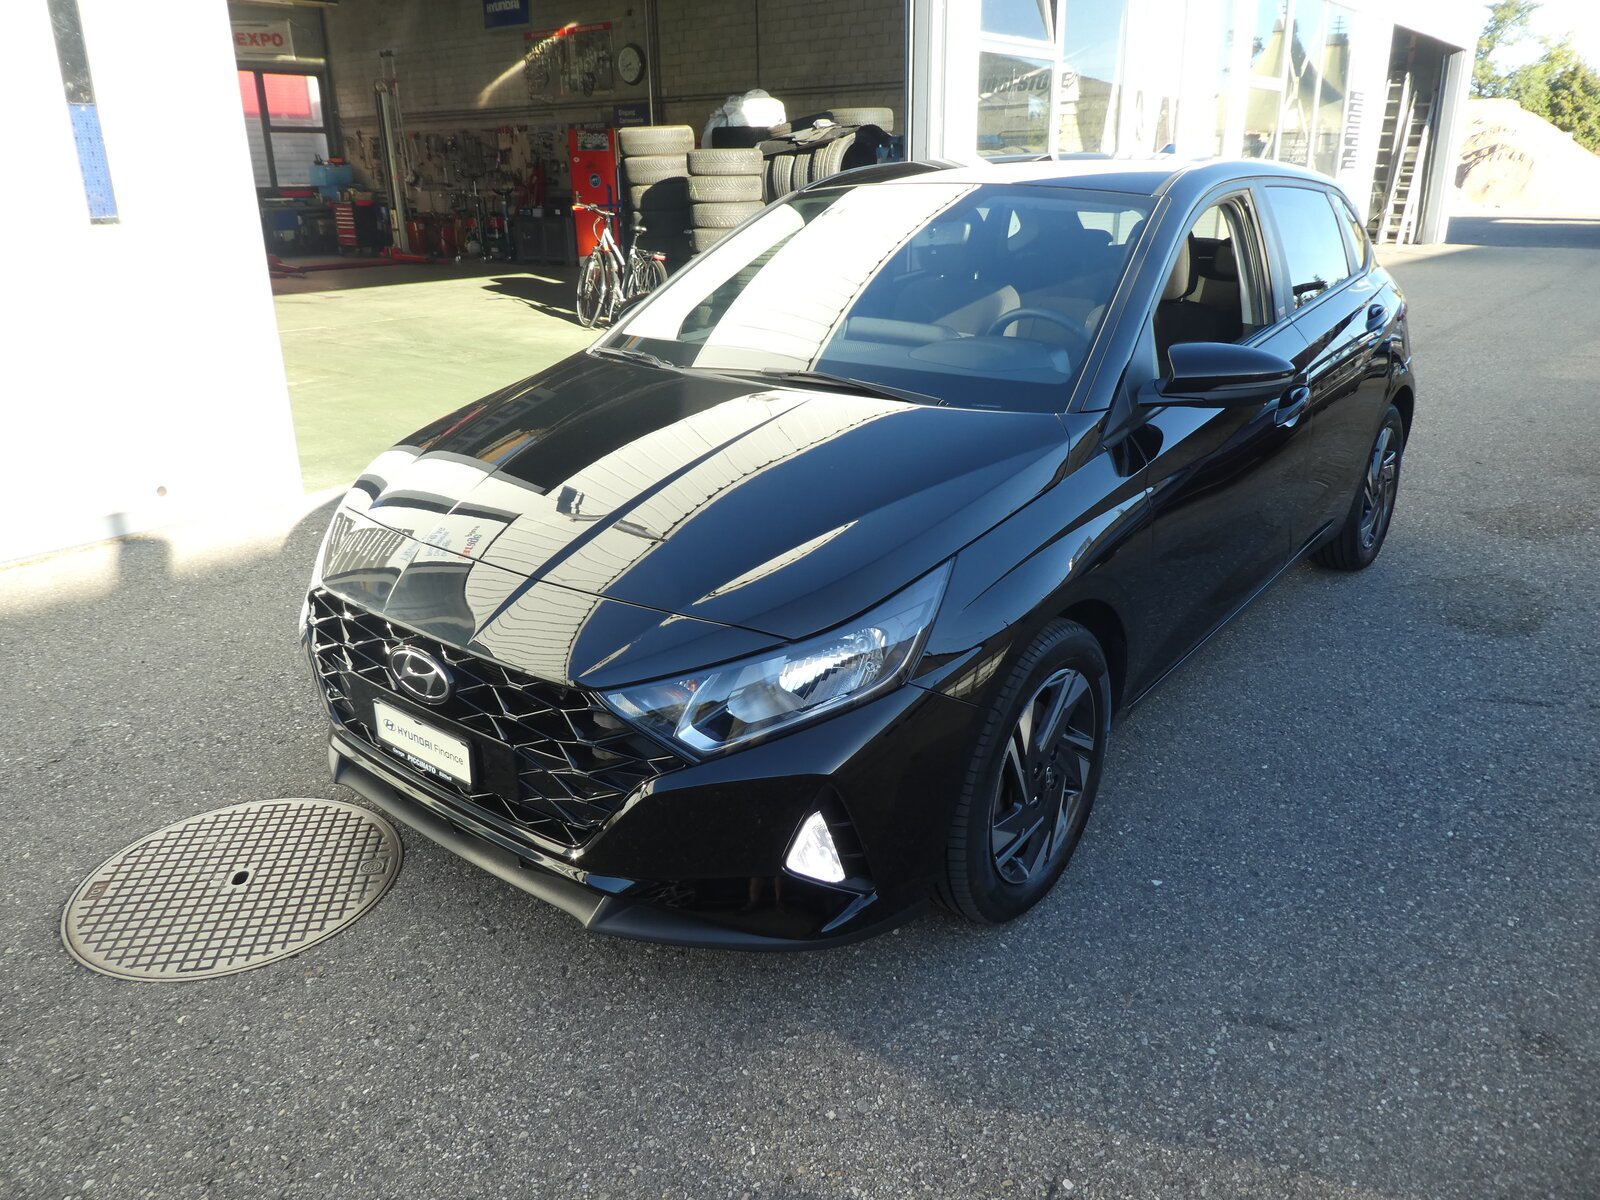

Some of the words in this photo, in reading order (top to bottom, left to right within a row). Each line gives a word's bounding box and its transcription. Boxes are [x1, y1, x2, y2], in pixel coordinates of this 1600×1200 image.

[486, 0, 520, 14] HYUNDAI
[397, 726, 433, 750] HYUNDAI
[434, 744, 464, 766] Finance
